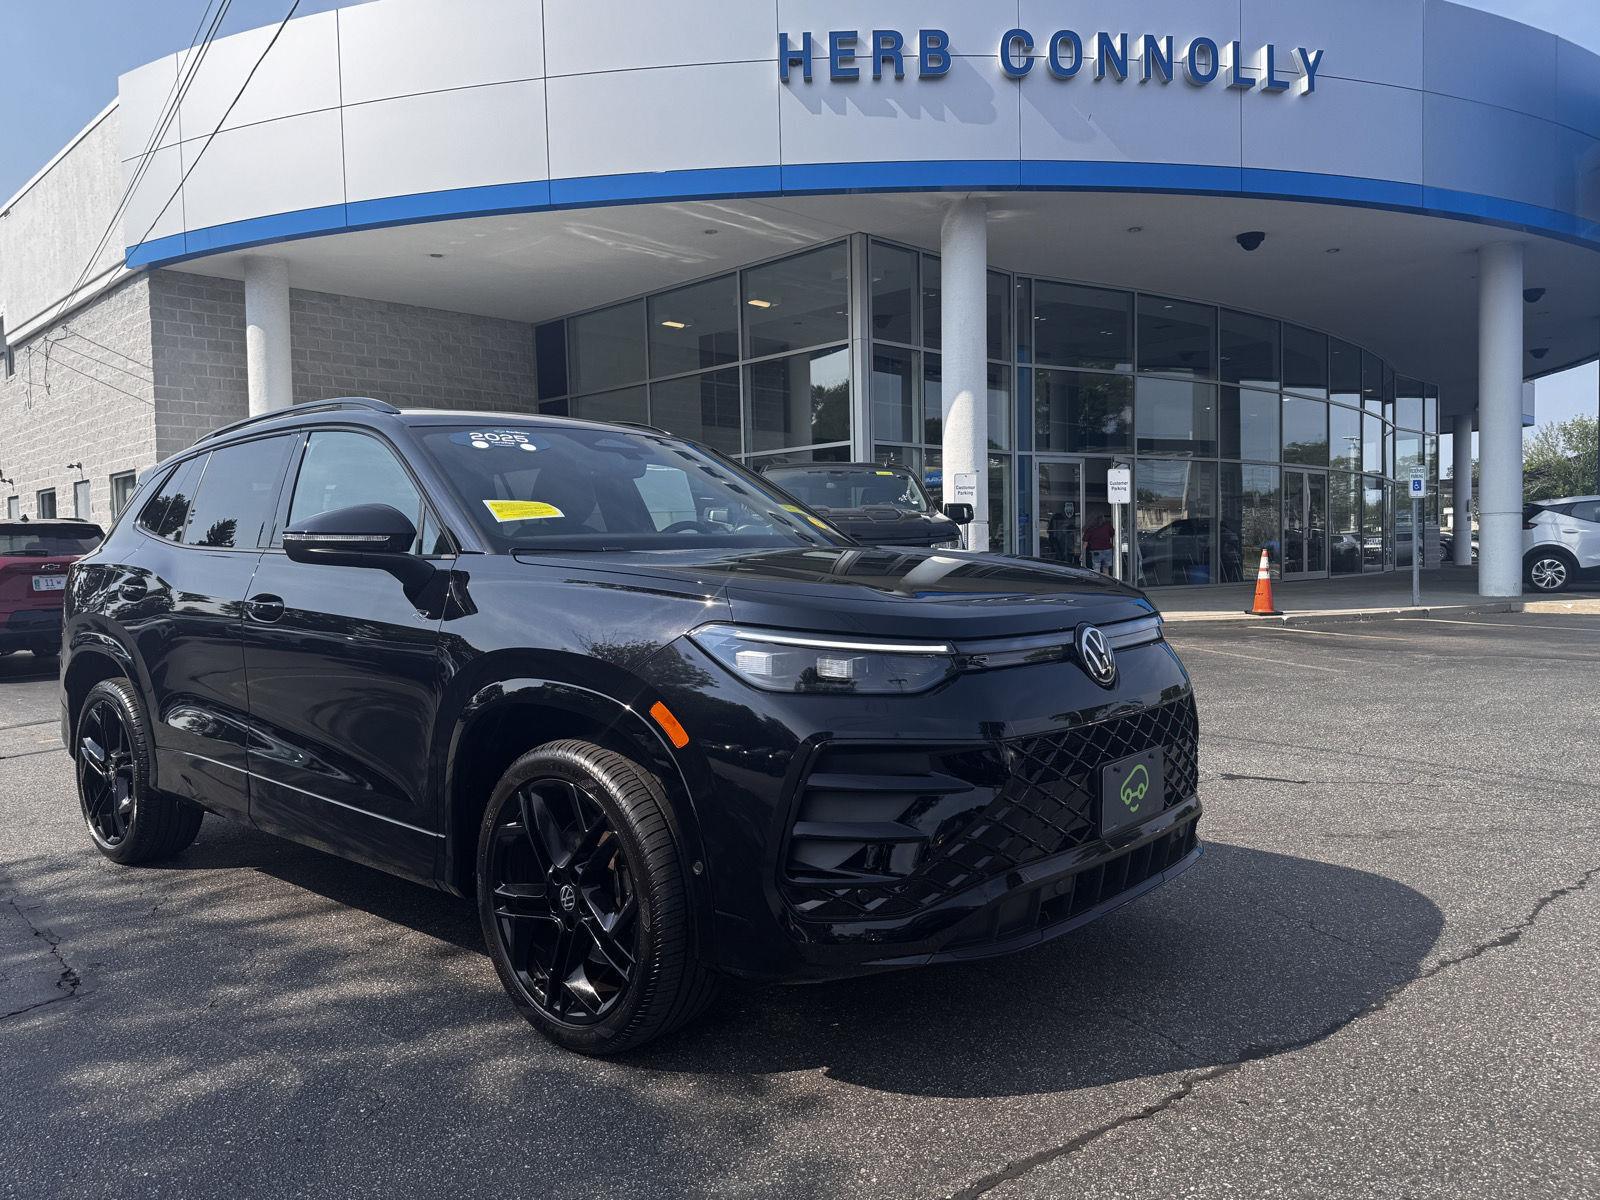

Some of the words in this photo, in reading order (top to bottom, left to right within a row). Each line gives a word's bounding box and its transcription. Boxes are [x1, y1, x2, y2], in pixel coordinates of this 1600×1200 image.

[778, 29, 953, 82] HERB
[996, 28, 1325, 96] CONNOLLY
[469, 432, 529, 443] 2025
